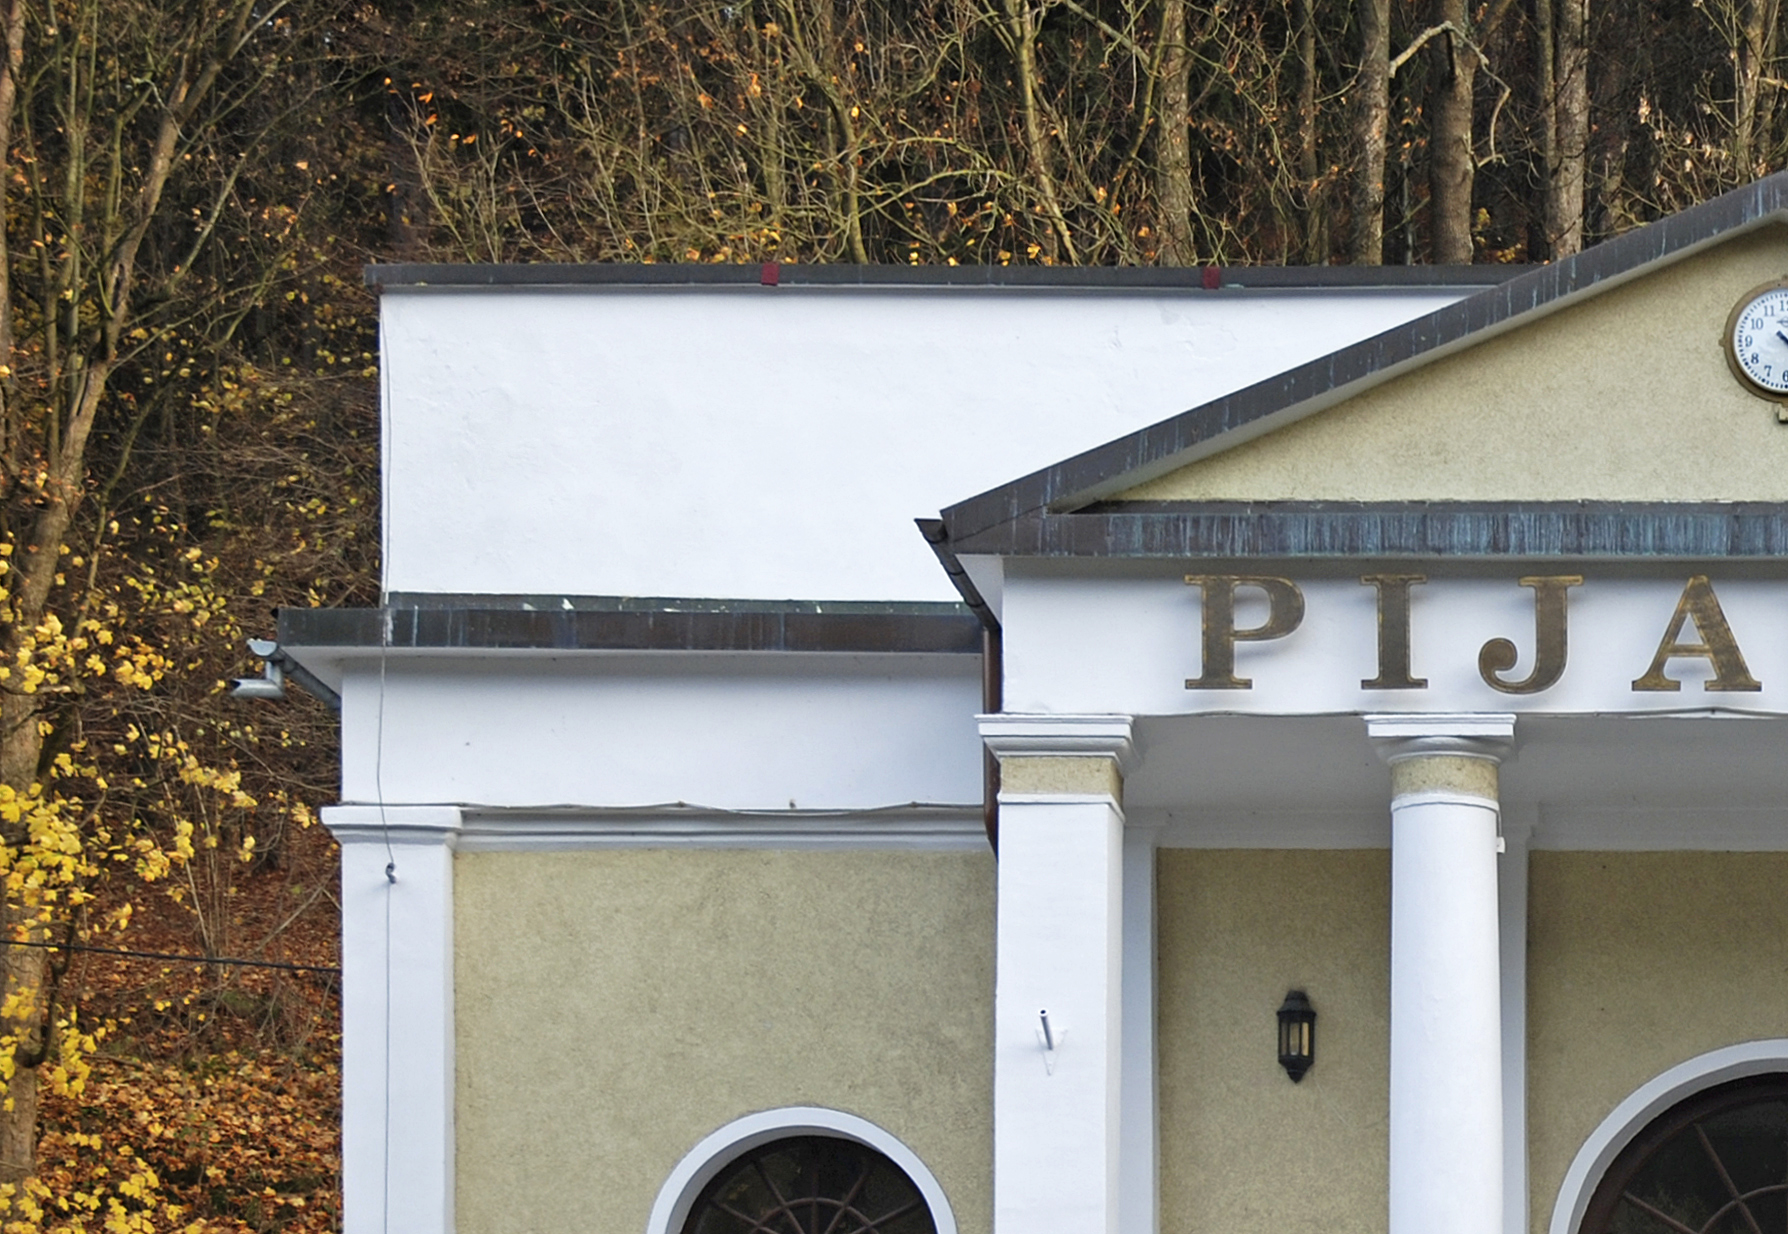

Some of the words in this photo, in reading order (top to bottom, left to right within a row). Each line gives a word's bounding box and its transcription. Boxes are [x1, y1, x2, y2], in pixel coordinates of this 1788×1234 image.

[1763, 306, 1775, 317] 11
[1750, 318, 1764, 330] 10
[1745, 335, 1753, 347] 9
[1750, 353, 1759, 365] 8
[1764, 365, 1772, 377] 7
